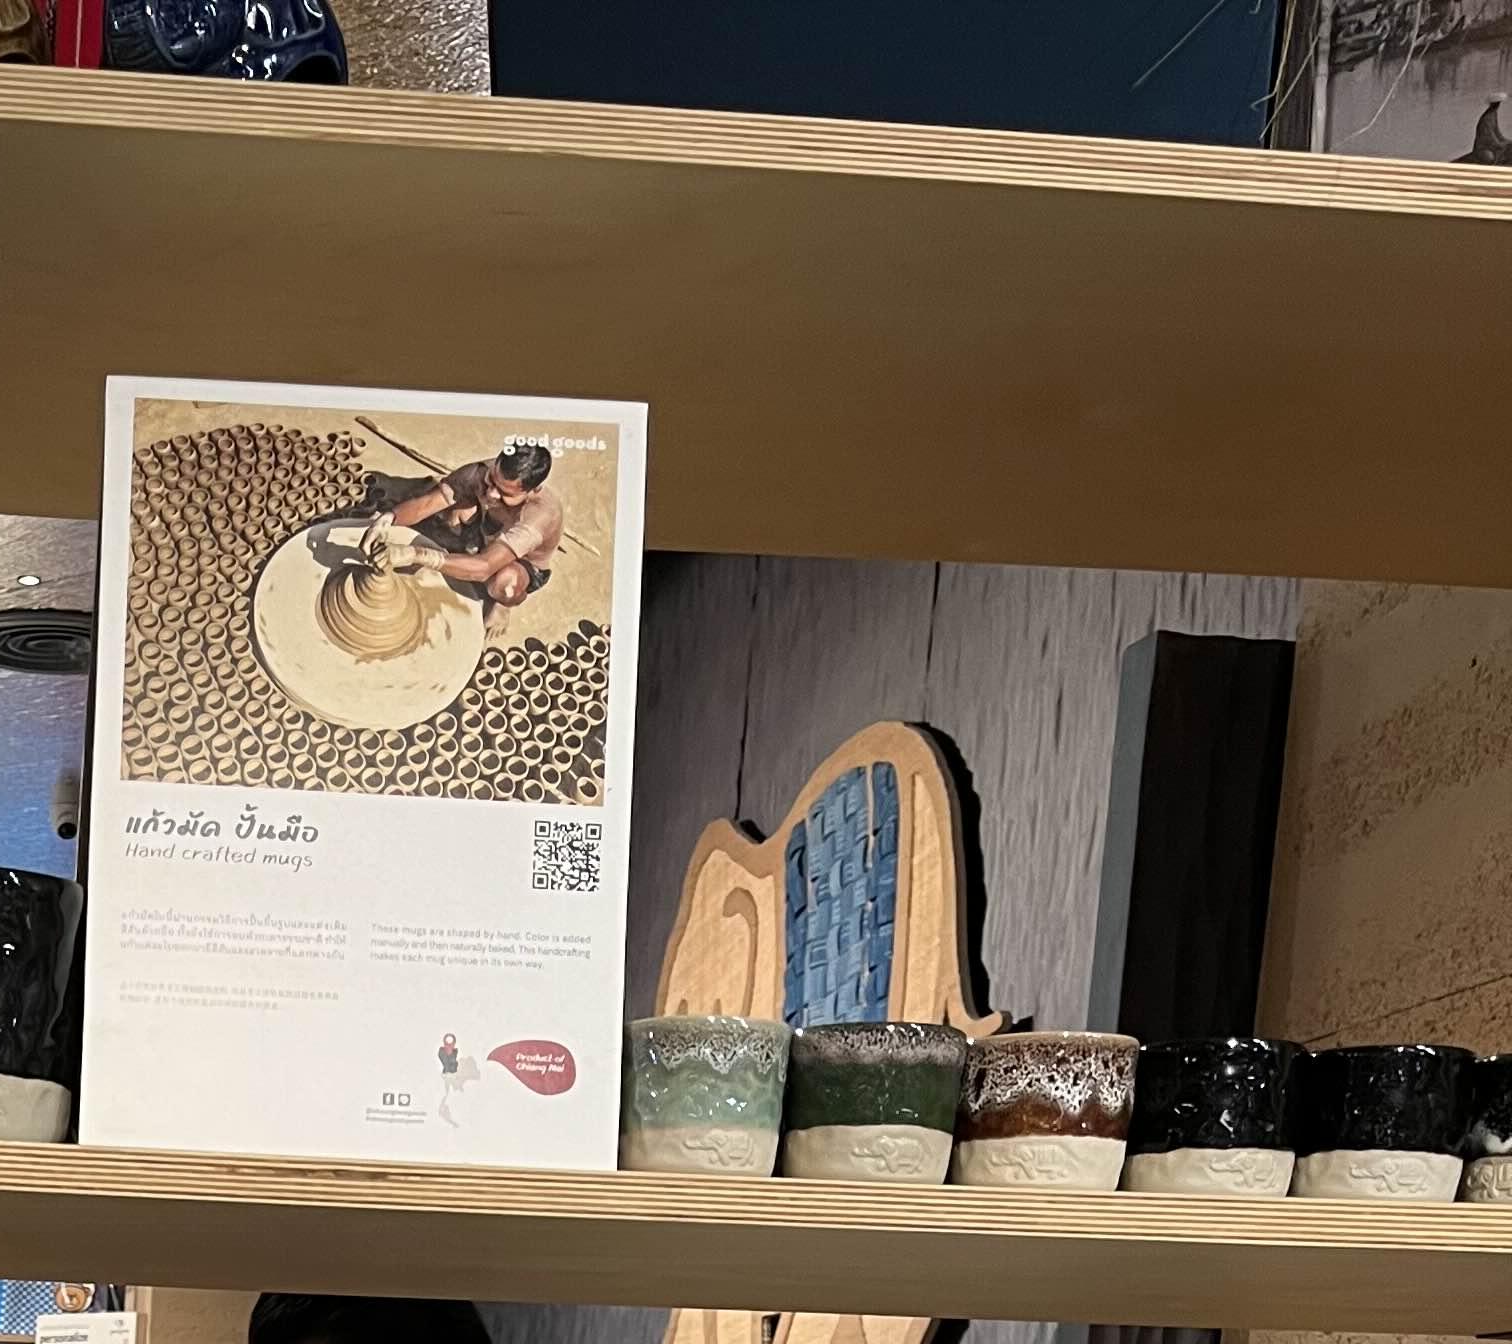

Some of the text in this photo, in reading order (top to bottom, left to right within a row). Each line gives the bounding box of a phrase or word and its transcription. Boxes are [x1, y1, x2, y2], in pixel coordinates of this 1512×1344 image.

[503, 433, 607, 458] good goods
[125, 843, 313, 873] Hand crafted mugs
